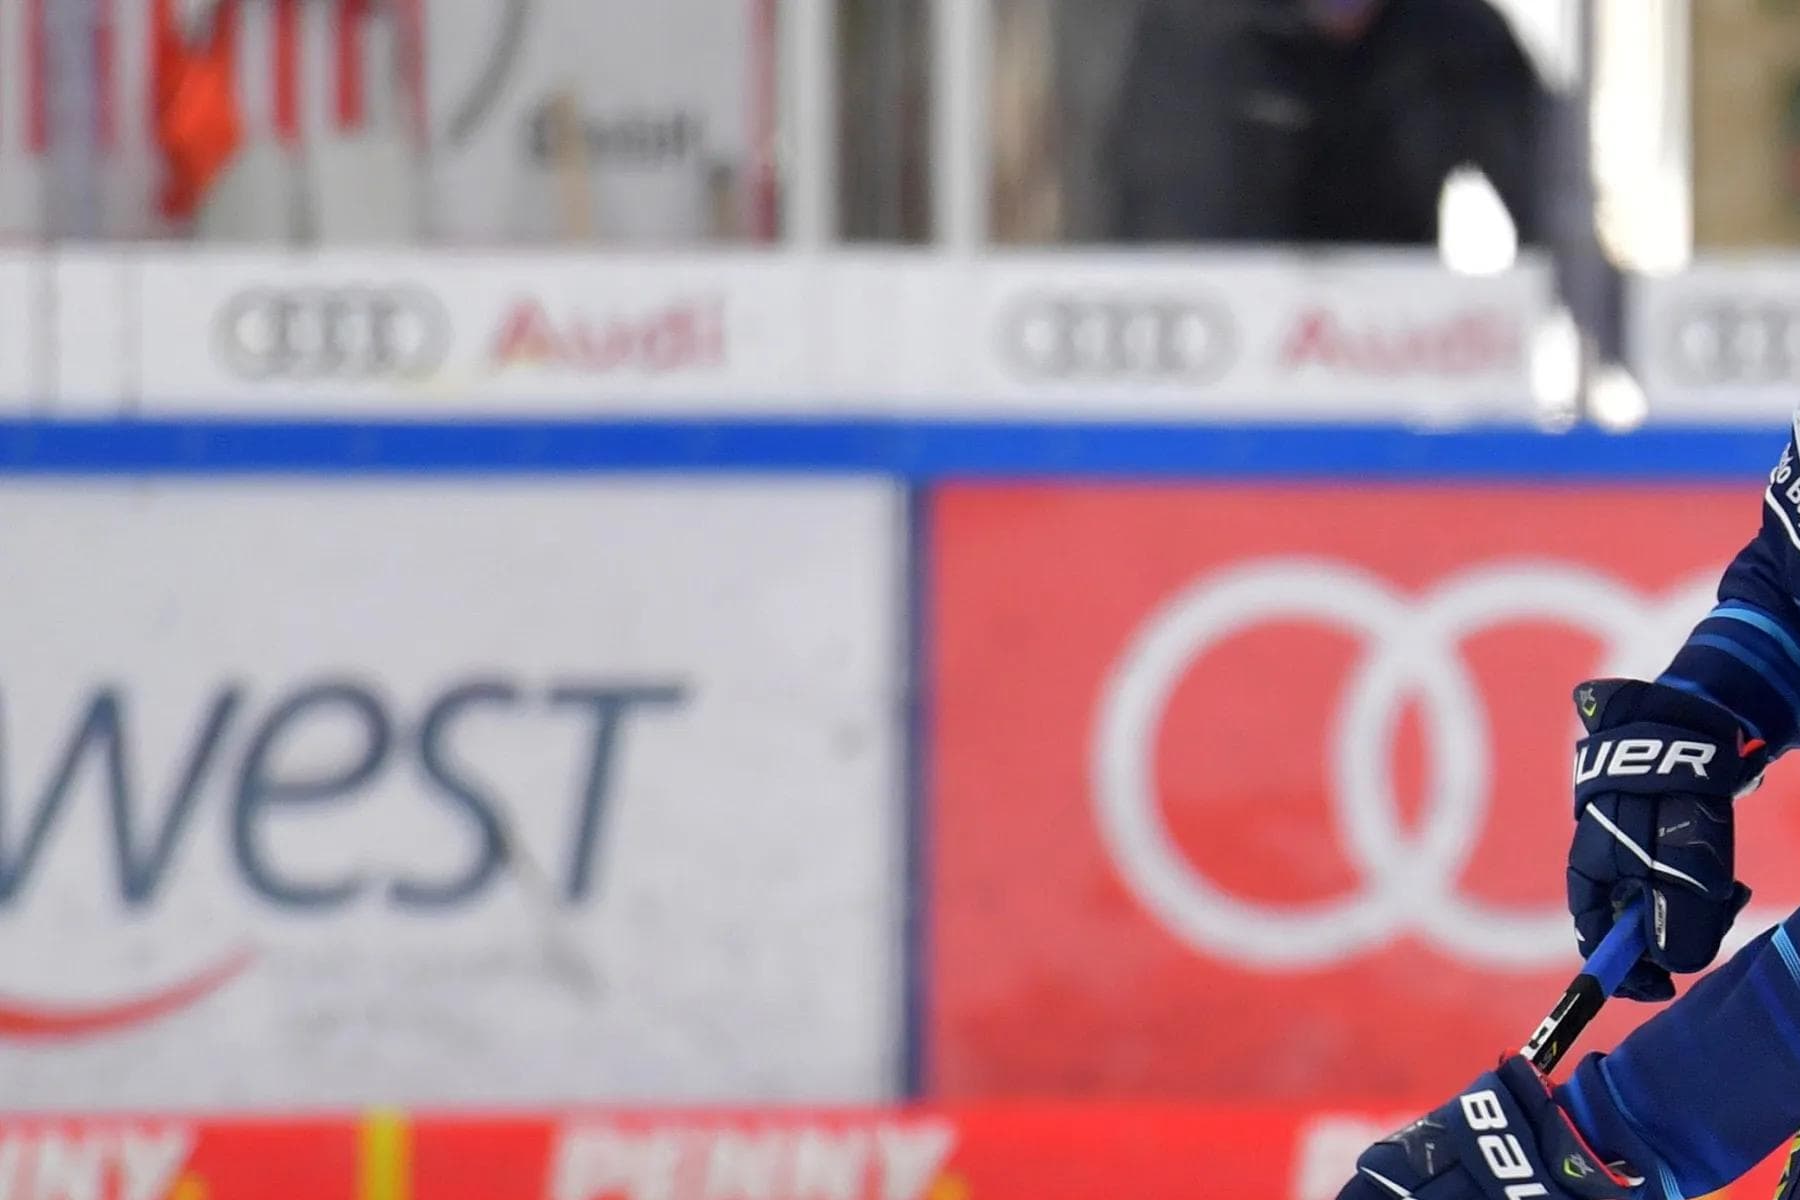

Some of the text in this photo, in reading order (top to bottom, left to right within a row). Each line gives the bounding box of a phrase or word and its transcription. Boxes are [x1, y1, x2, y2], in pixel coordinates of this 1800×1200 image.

[492, 293, 728, 374] Audi
[1280, 304, 1524, 376] Audi
[1573, 738, 1717, 785] UER
